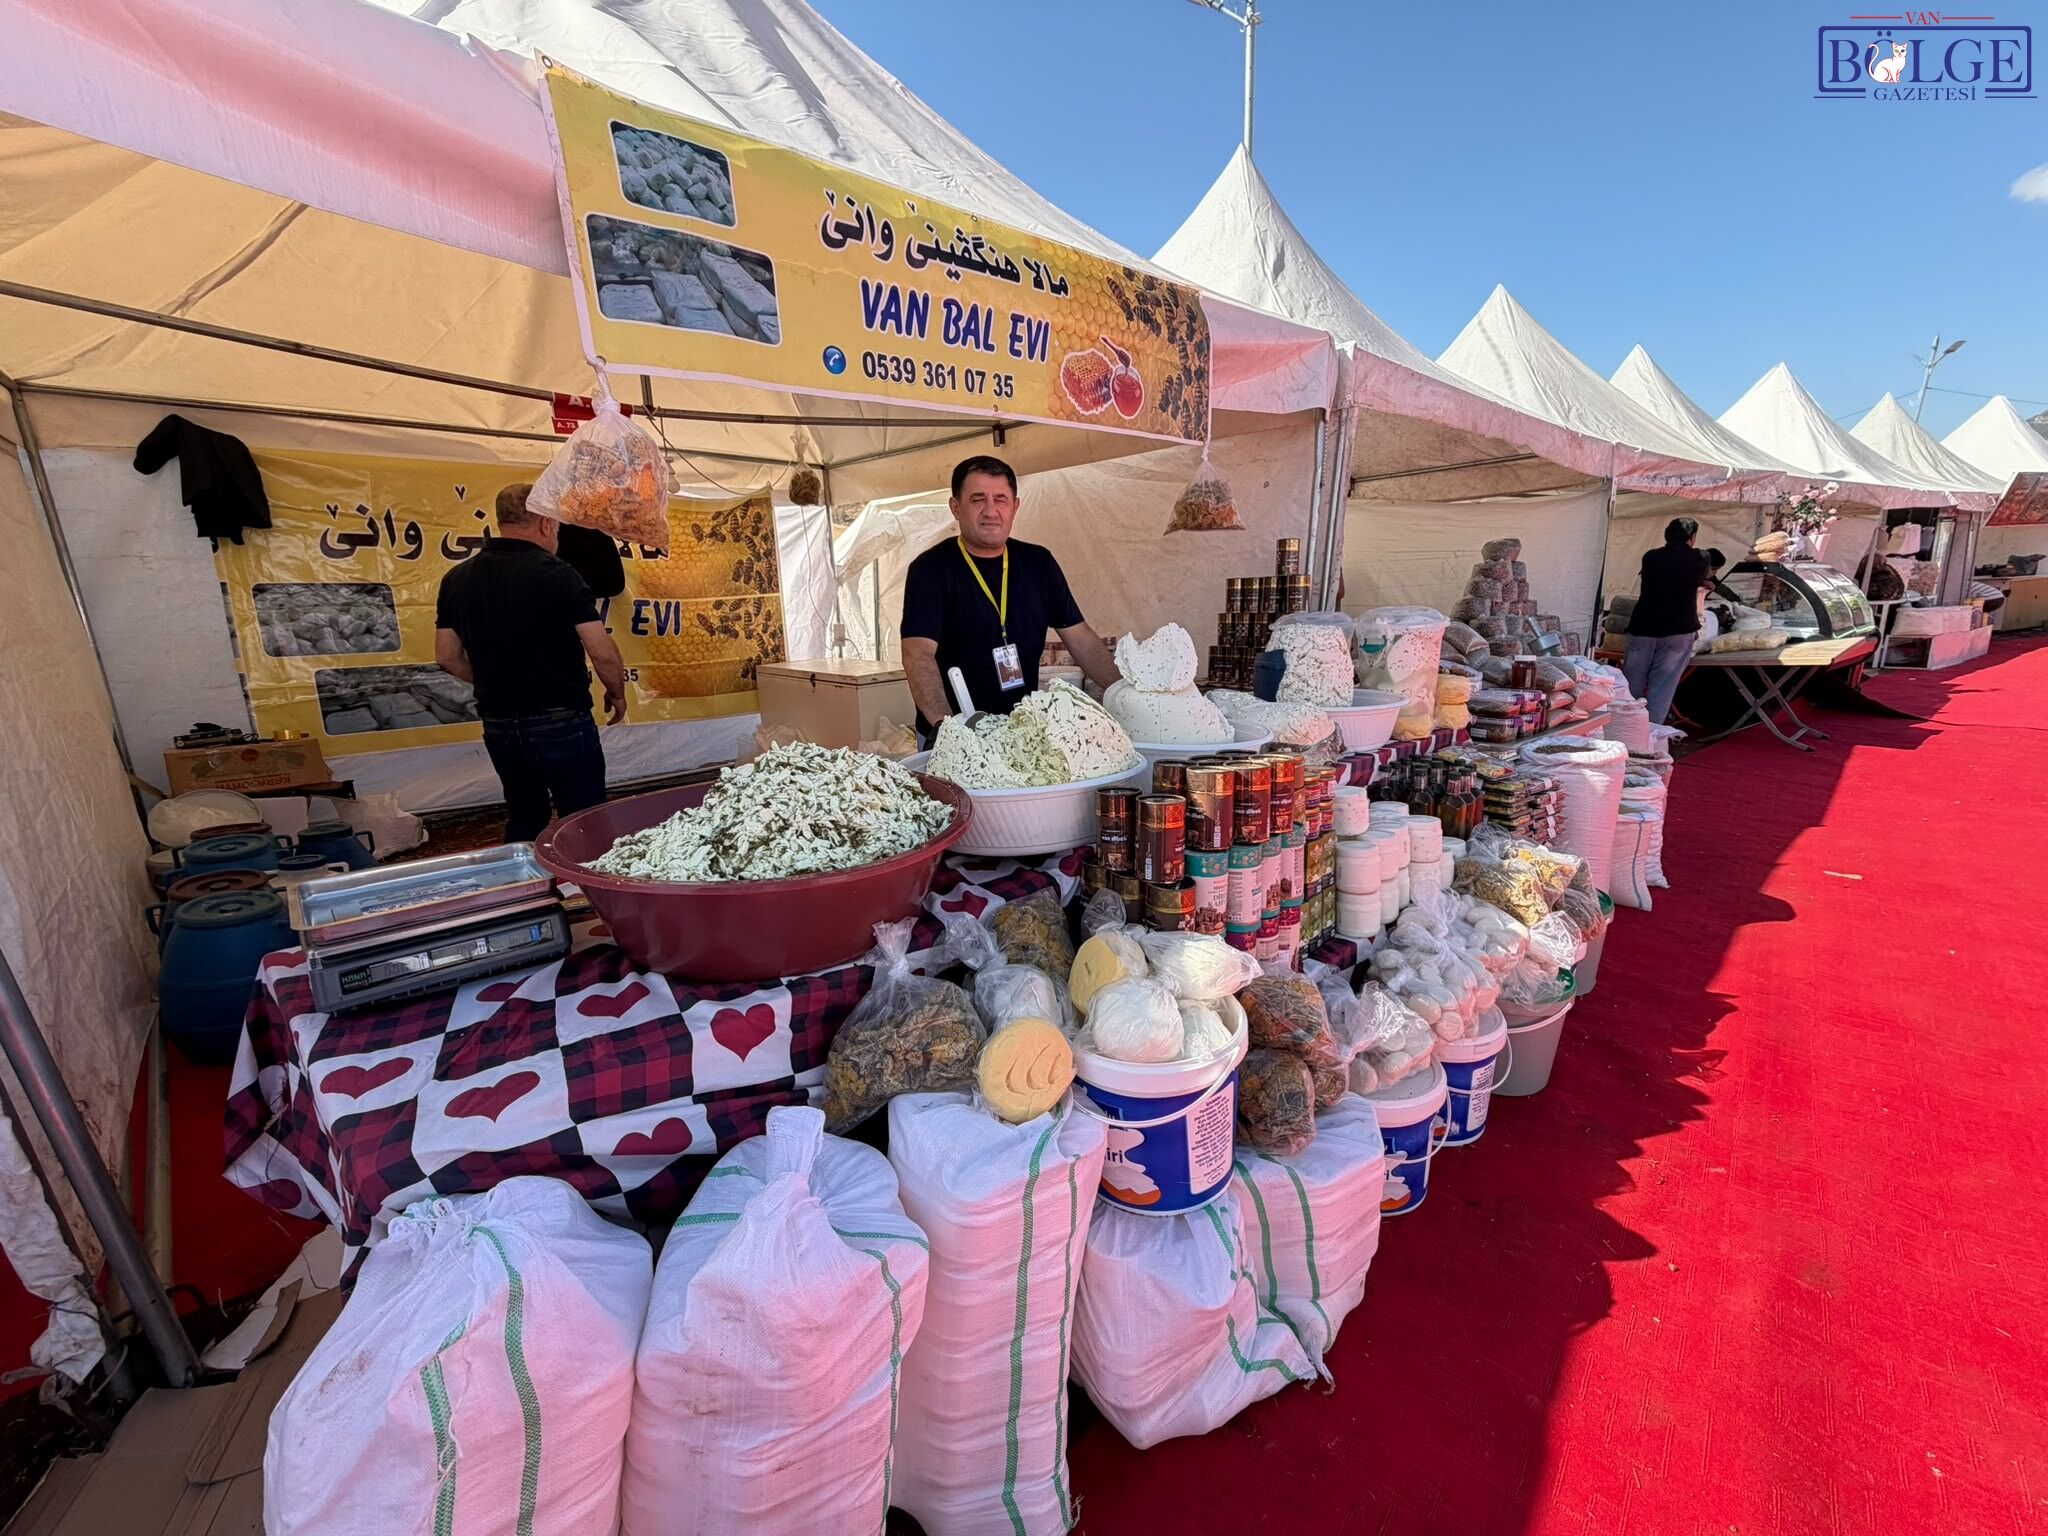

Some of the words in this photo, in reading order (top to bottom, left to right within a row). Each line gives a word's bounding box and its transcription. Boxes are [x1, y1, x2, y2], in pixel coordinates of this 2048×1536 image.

[1022, 256, 1069, 297] مالا
[861, 279, 930, 339] VAN
[943, 298, 997, 352] BAL
[1009, 313, 1050, 363] EVI
[862, 351, 916, 384] 0539
[923, 361, 957, 390] 361
[964, 368, 987, 394] 07
[993, 373, 1014, 398] 35
[631, 599, 681, 636] EVI
